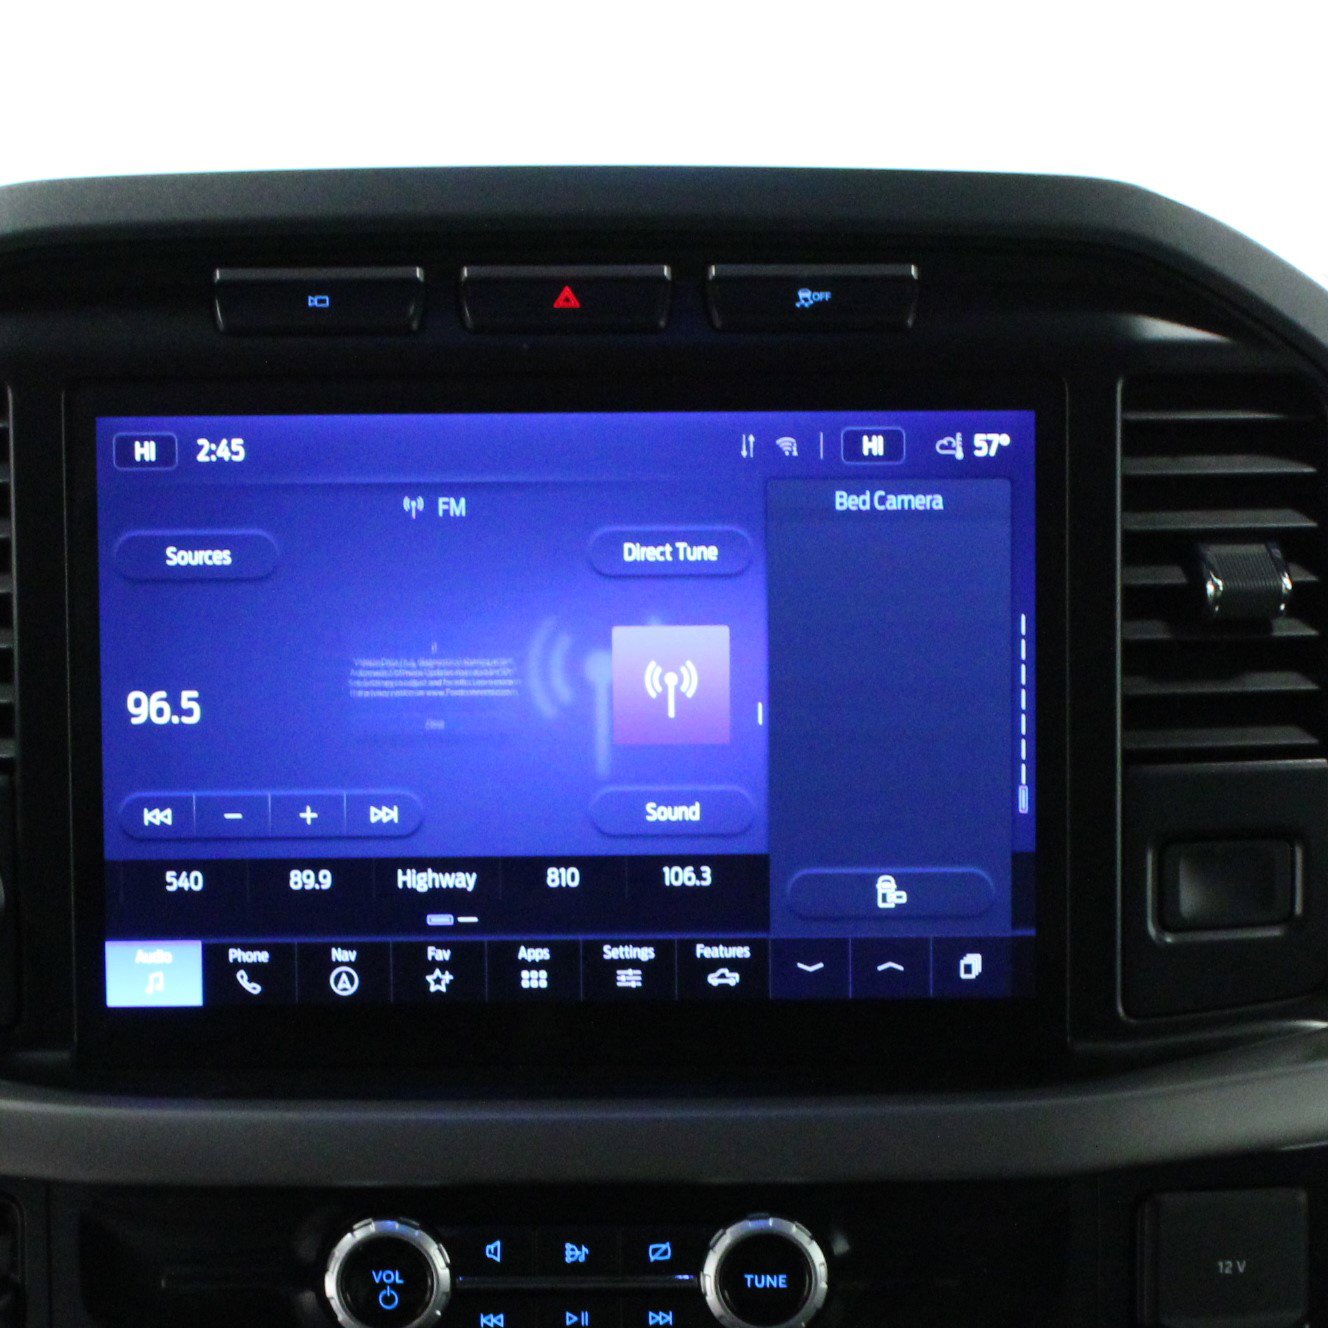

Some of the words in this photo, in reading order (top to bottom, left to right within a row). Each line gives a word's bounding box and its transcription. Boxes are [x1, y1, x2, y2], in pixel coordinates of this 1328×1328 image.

[812, 291, 831, 302] OFF
[134, 440, 157, 462] HI
[196, 437, 246, 463] 2:45
[861, 434, 885, 457] HI
[973, 432, 1011, 458] 57°
[437, 496, 467, 517] FM
[834, 489, 871, 511] Bed
[873, 489, 944, 511] Camera
[165, 545, 233, 567] Sources
[622, 541, 674, 563] Direct
[674, 541, 719, 562] Tune
[126, 689, 202, 725] 96.5
[645, 801, 701, 822] Sound
[165, 870, 204, 892] 540
[289, 868, 333, 891] 89.9
[396, 867, 478, 893] Highway
[546, 866, 581, 888] 810
[662, 865, 712, 887] 106.3
[134, 948, 174, 965] Audio
[228, 947, 270, 964] Phone
[331, 947, 357, 963] Nav
[427, 945, 452, 962] Fav
[517, 945, 551, 963] Apps
[602, 944, 656, 962] Settings
[695, 943, 751, 959] Features
[371, 1269, 404, 1286] VOL
[1217, 1260, 1233, 1274] 12
[1236, 1260, 1247, 1273] V
[744, 1274, 788, 1289] TUNE
